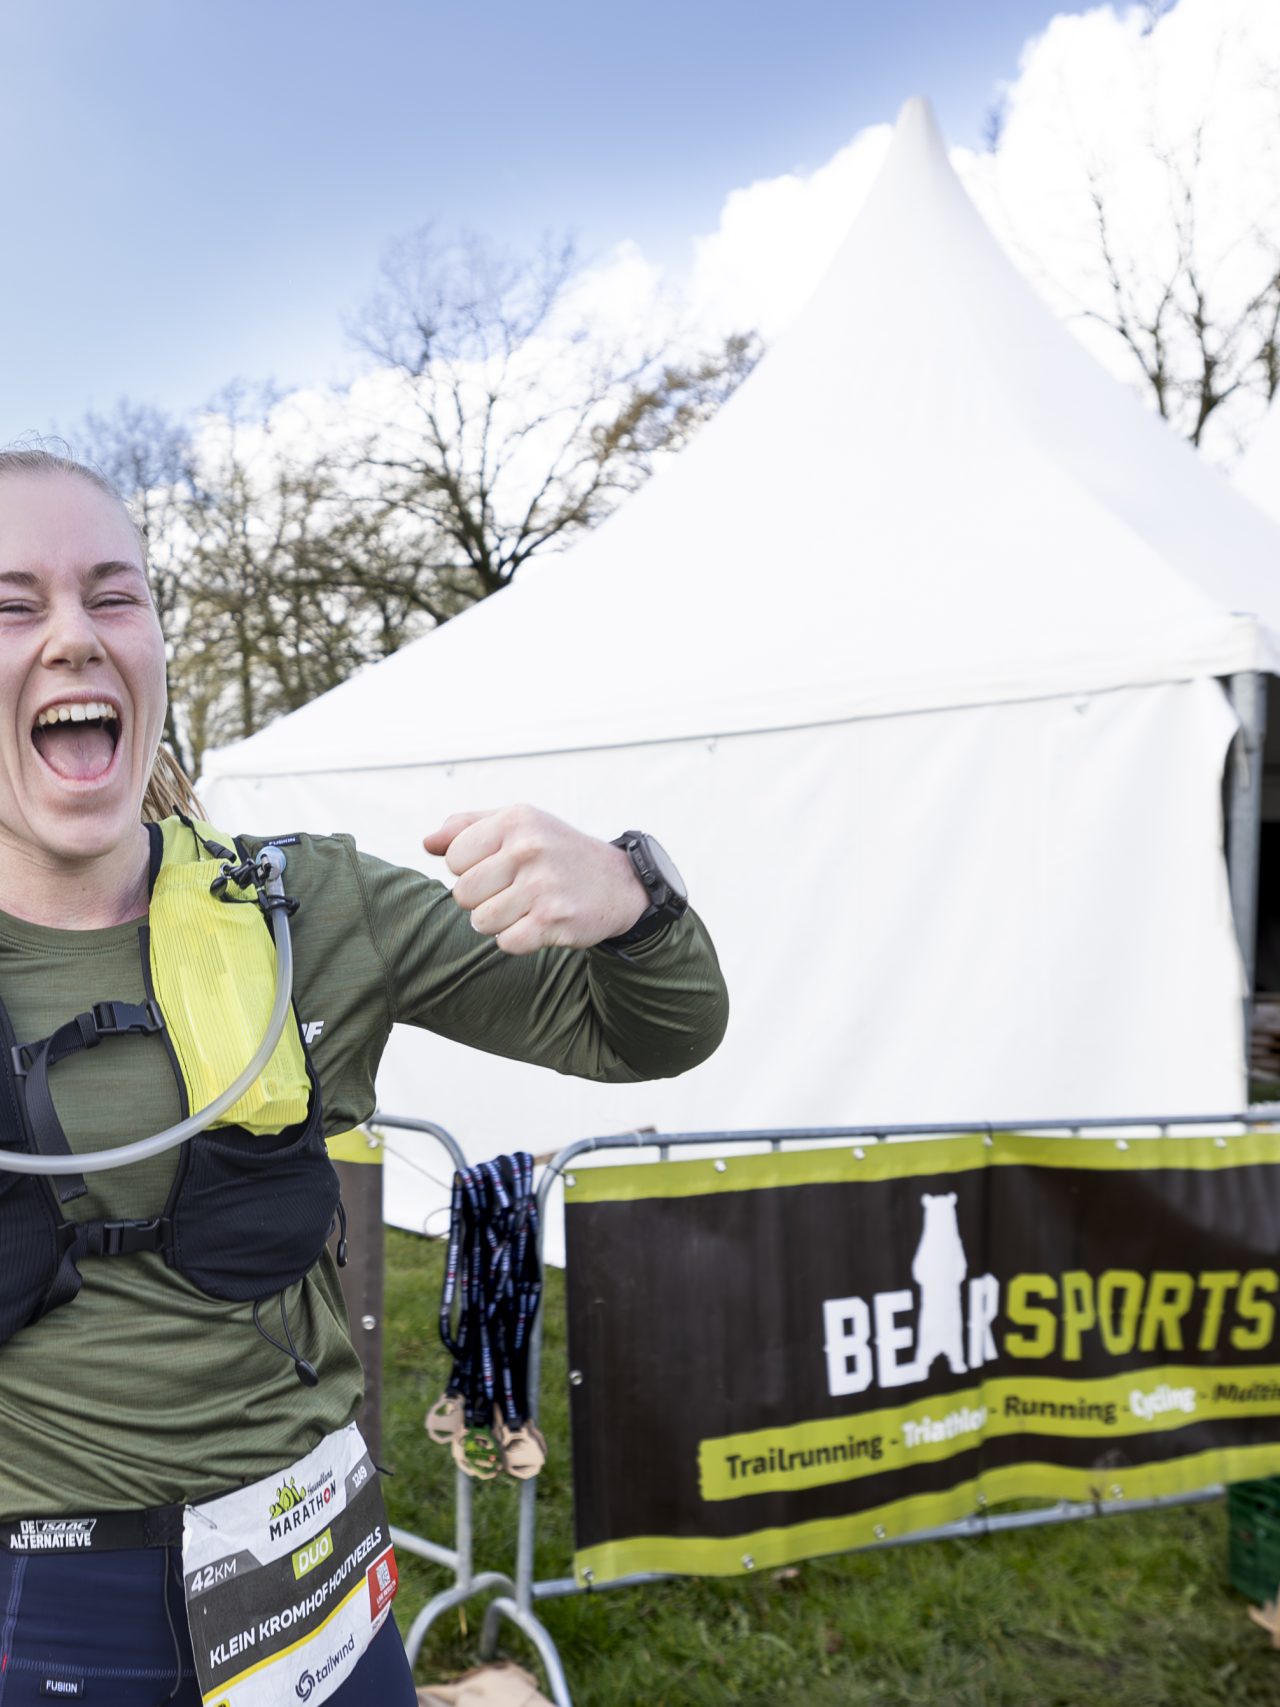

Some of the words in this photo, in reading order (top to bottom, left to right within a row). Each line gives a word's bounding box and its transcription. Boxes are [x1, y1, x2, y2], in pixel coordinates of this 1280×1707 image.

[726, 1435, 883, 1480] Trailrunning
[1004, 1396, 1117, 1425] Running
[1129, 1384, 1196, 1419] Cycling
[20, 1520, 36, 1534] DE
[269, 1480, 336, 1541] MARATHON
[10, 1532, 92, 1549] ALTERNATIEVE
[298, 1537, 330, 1573] DUO
[191, 1558, 237, 1592] 42KM
[209, 1627, 256, 1669] KLEIN
[315, 1635, 356, 1684] tailwind
[46, 1680, 78, 1694] FUSION
